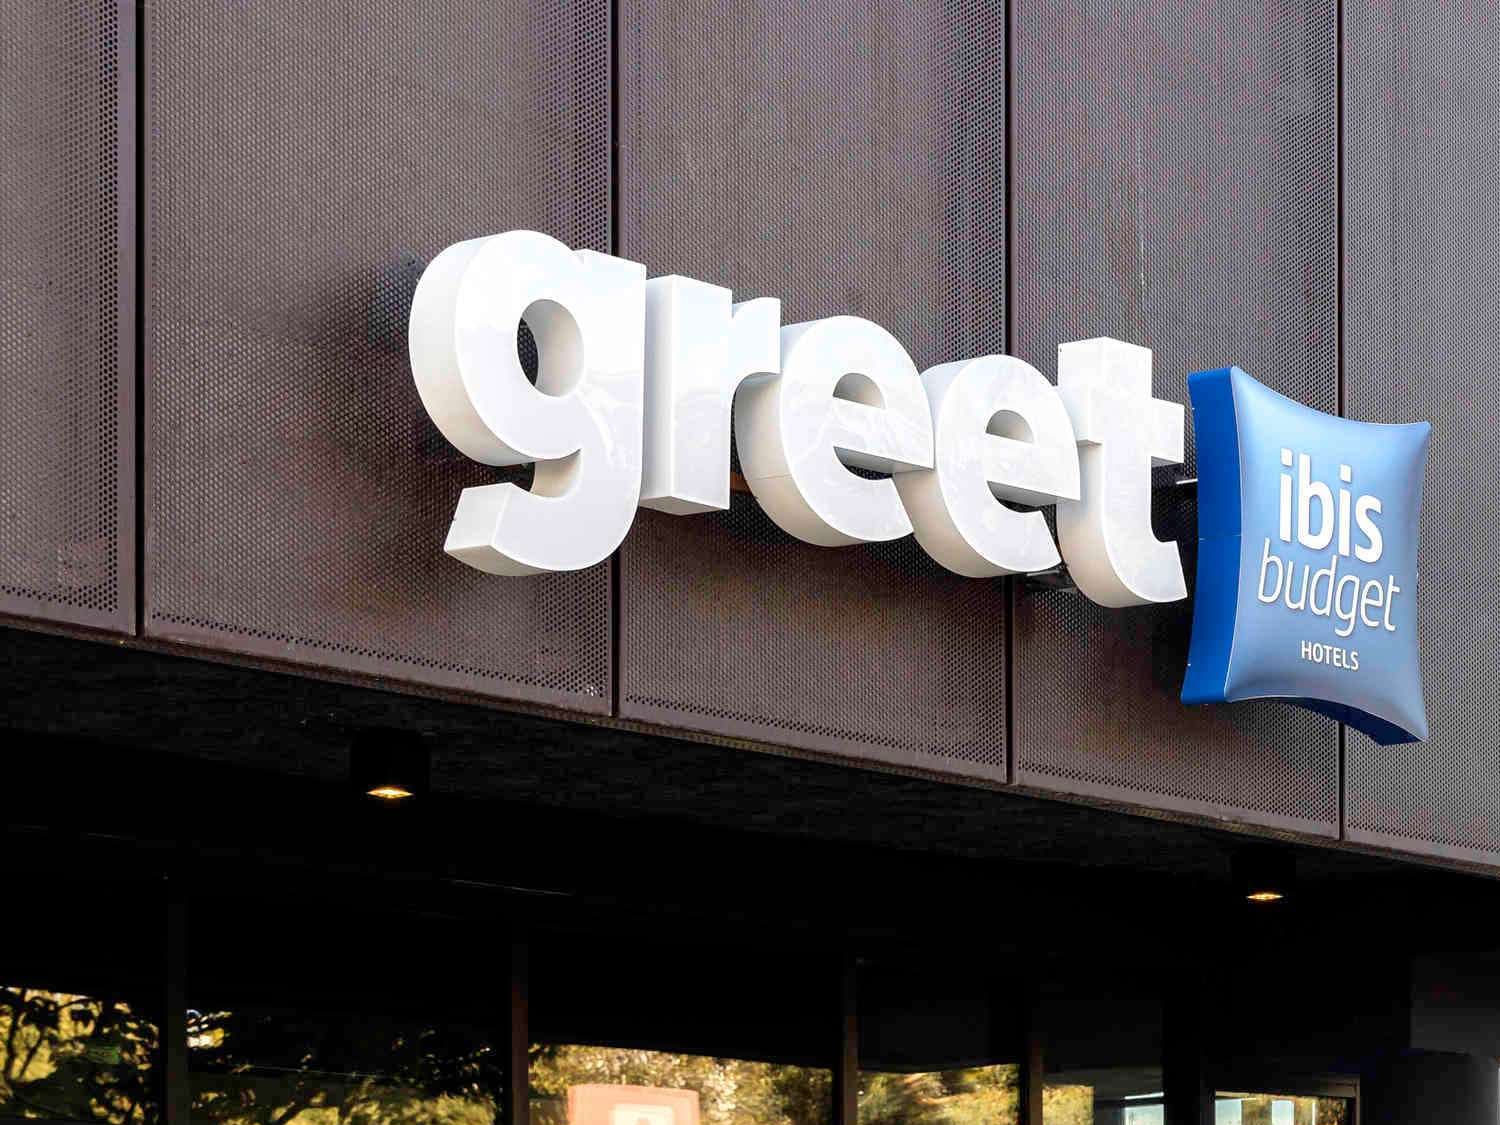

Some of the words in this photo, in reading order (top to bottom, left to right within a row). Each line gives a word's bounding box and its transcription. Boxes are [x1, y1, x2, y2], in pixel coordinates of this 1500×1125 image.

[409, 230, 1188, 607] greet
[1279, 448, 1384, 564] ibis
[1257, 537, 1401, 637] budget
[1300, 640, 1360, 671] HOTELS
